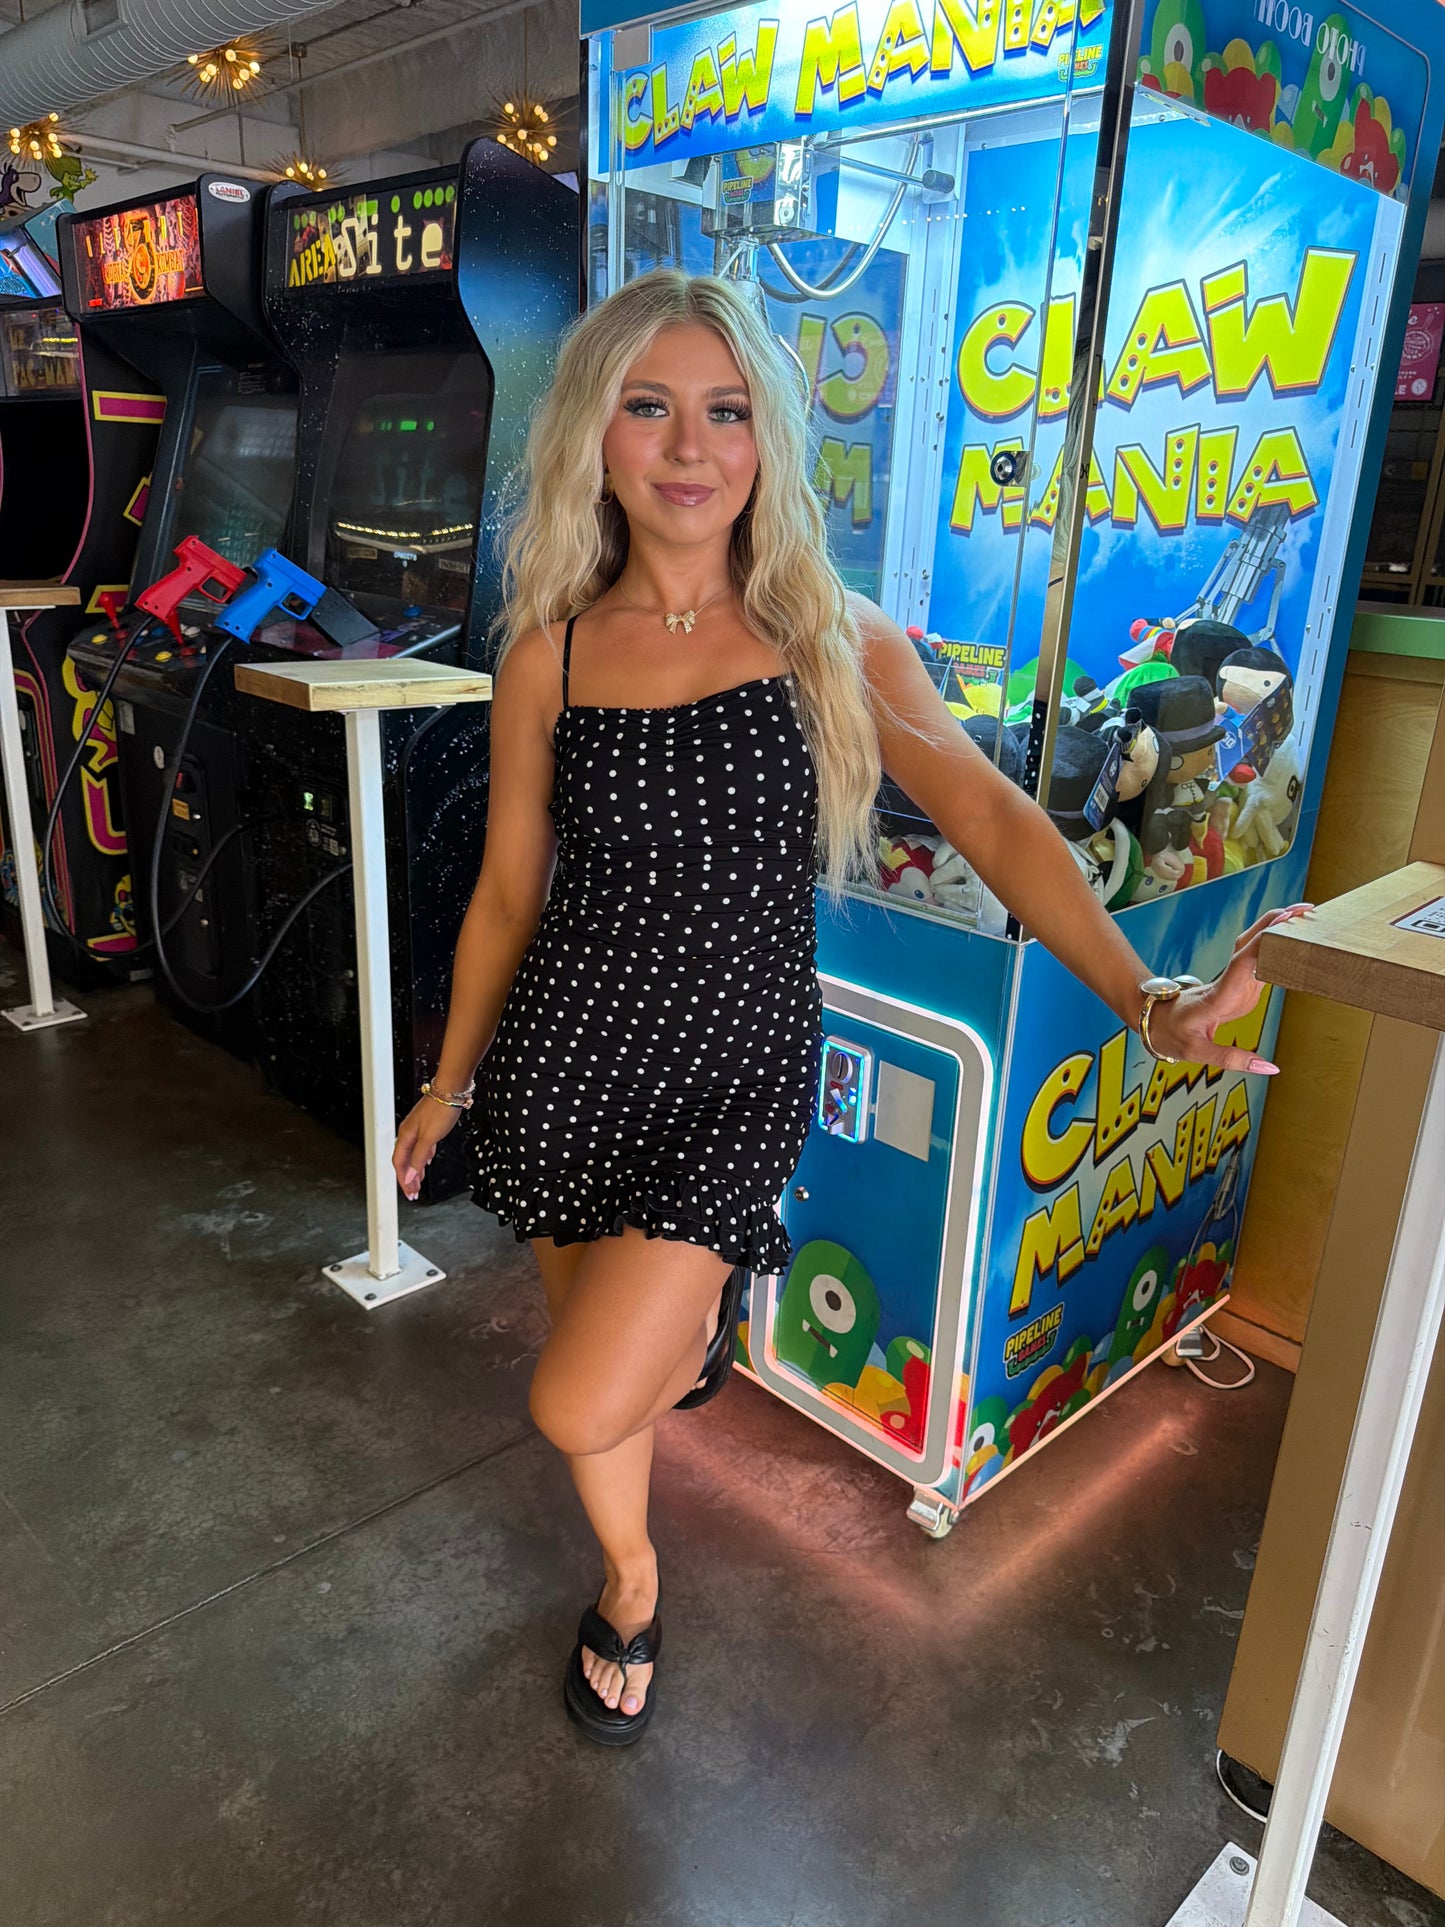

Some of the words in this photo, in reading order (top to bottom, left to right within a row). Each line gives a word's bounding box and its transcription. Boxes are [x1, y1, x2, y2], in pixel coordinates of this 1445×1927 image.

[618, 18, 780, 151] CLAW
[723, 178, 752, 192] PIPELINE
[156, 249, 185, 275] KOMBAT
[288, 232, 336, 288] AREA
[338, 214, 443, 278] Site
[958, 246, 1358, 420] CLAW
[950, 424, 1318, 534] MANIA
[938, 643, 1004, 667] PIPELINE
[1009, 1079, 1250, 1318] MANIA
[1005, 1306, 1062, 1359] PIPELINE
